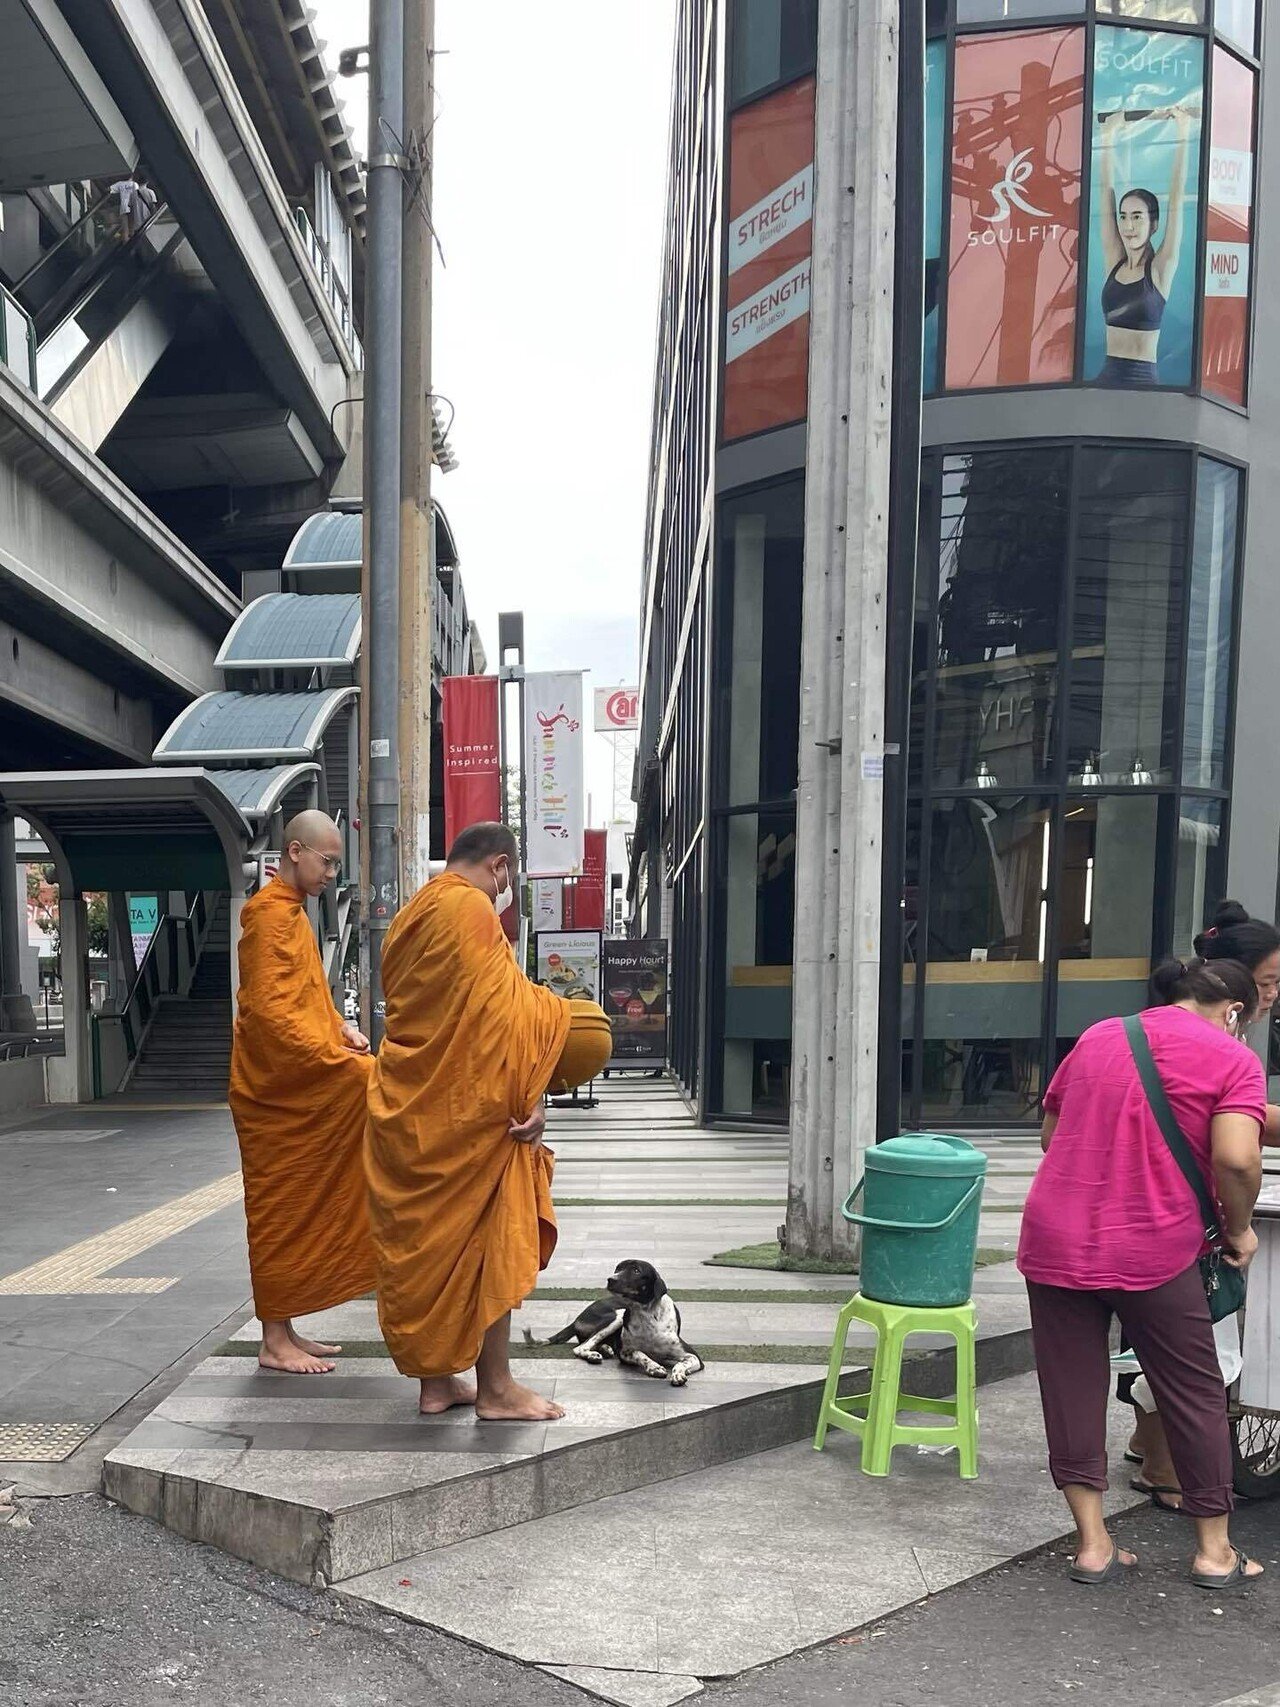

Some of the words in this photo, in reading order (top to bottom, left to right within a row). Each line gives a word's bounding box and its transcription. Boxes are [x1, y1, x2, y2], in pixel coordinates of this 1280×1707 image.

[1099, 51, 1192, 79] SOULFIT
[1211, 158, 1243, 181] BODY
[738, 180, 806, 246] STRECH
[967, 224, 1061, 247] SOULFIT
[1210, 253, 1239, 275] MIND
[731, 268, 811, 336] STRENGTH
[450, 744, 495, 753] Summer
[536, 703, 570, 792] Summer
[446, 756, 498, 767] Inspired
[608, 956, 638, 966] Happy
